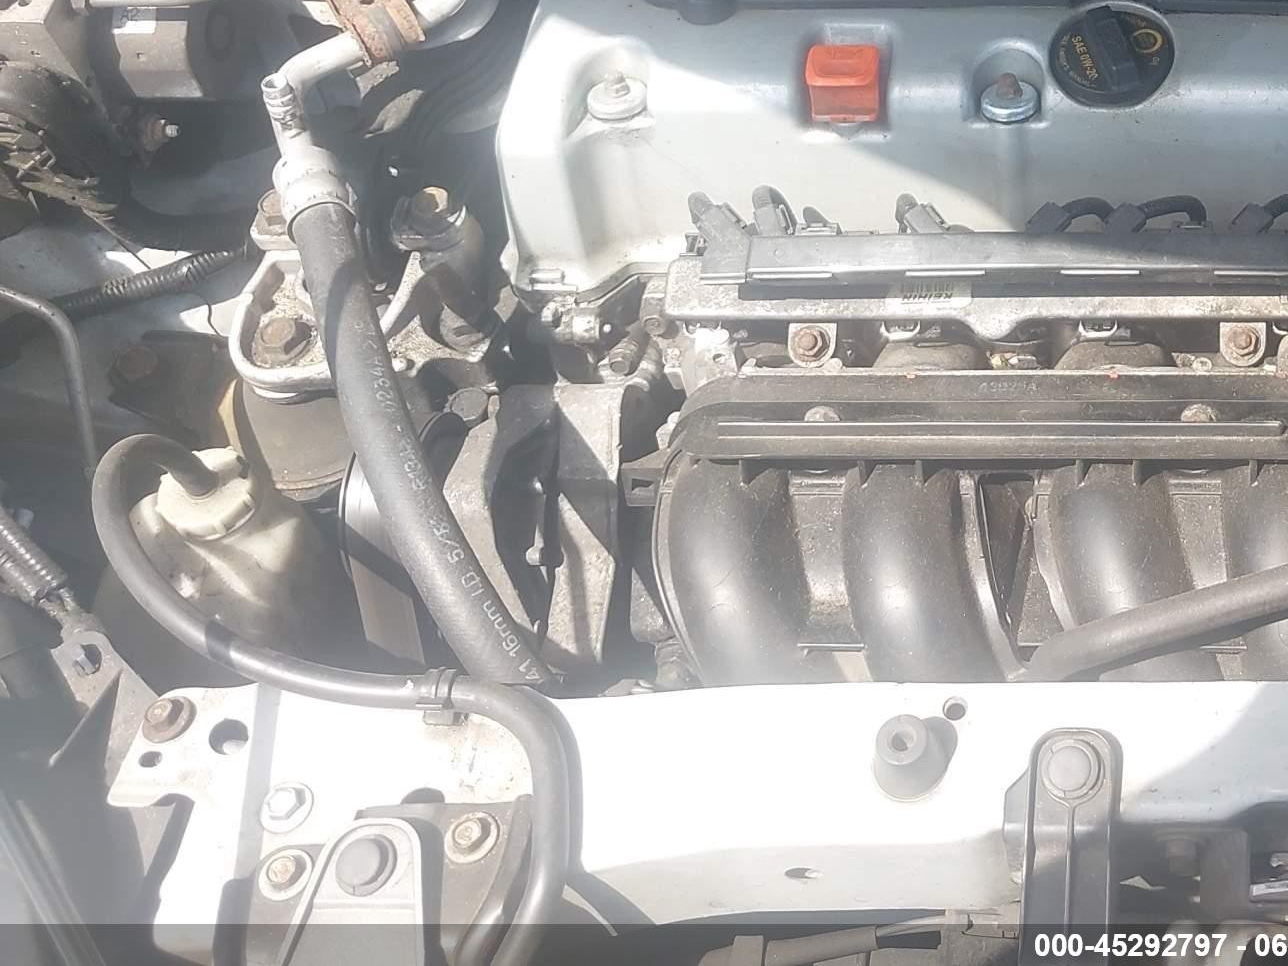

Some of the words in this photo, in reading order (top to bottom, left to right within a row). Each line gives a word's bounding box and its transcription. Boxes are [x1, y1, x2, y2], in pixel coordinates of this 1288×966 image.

[1071, 35, 1087, 54] SAE
[1079, 51, 1099, 82] 0W-20
[482, 600, 521, 657] 16mm
